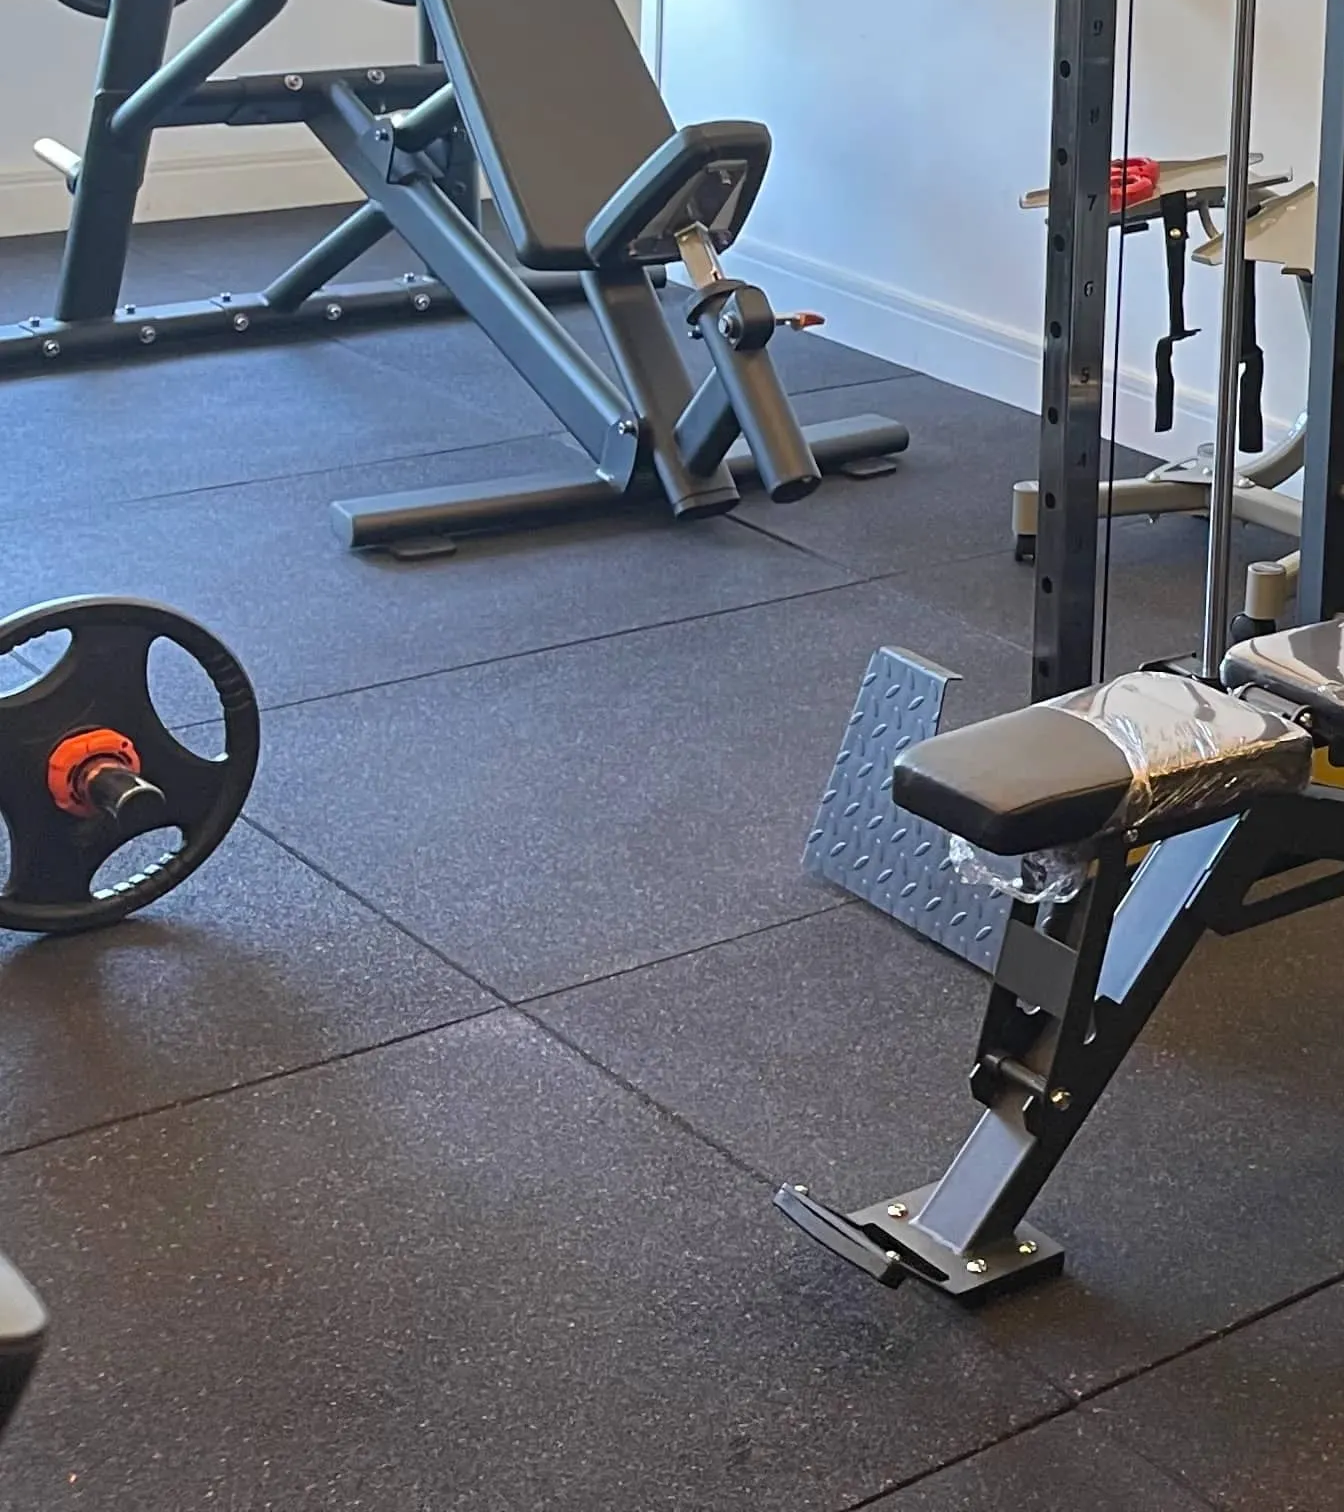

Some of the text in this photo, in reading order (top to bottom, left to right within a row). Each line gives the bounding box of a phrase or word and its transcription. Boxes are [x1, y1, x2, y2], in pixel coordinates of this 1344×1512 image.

[1087, 194, 1098, 211] 7
[1083, 280, 1094, 297] 6
[1079, 366, 1091, 384] 5
